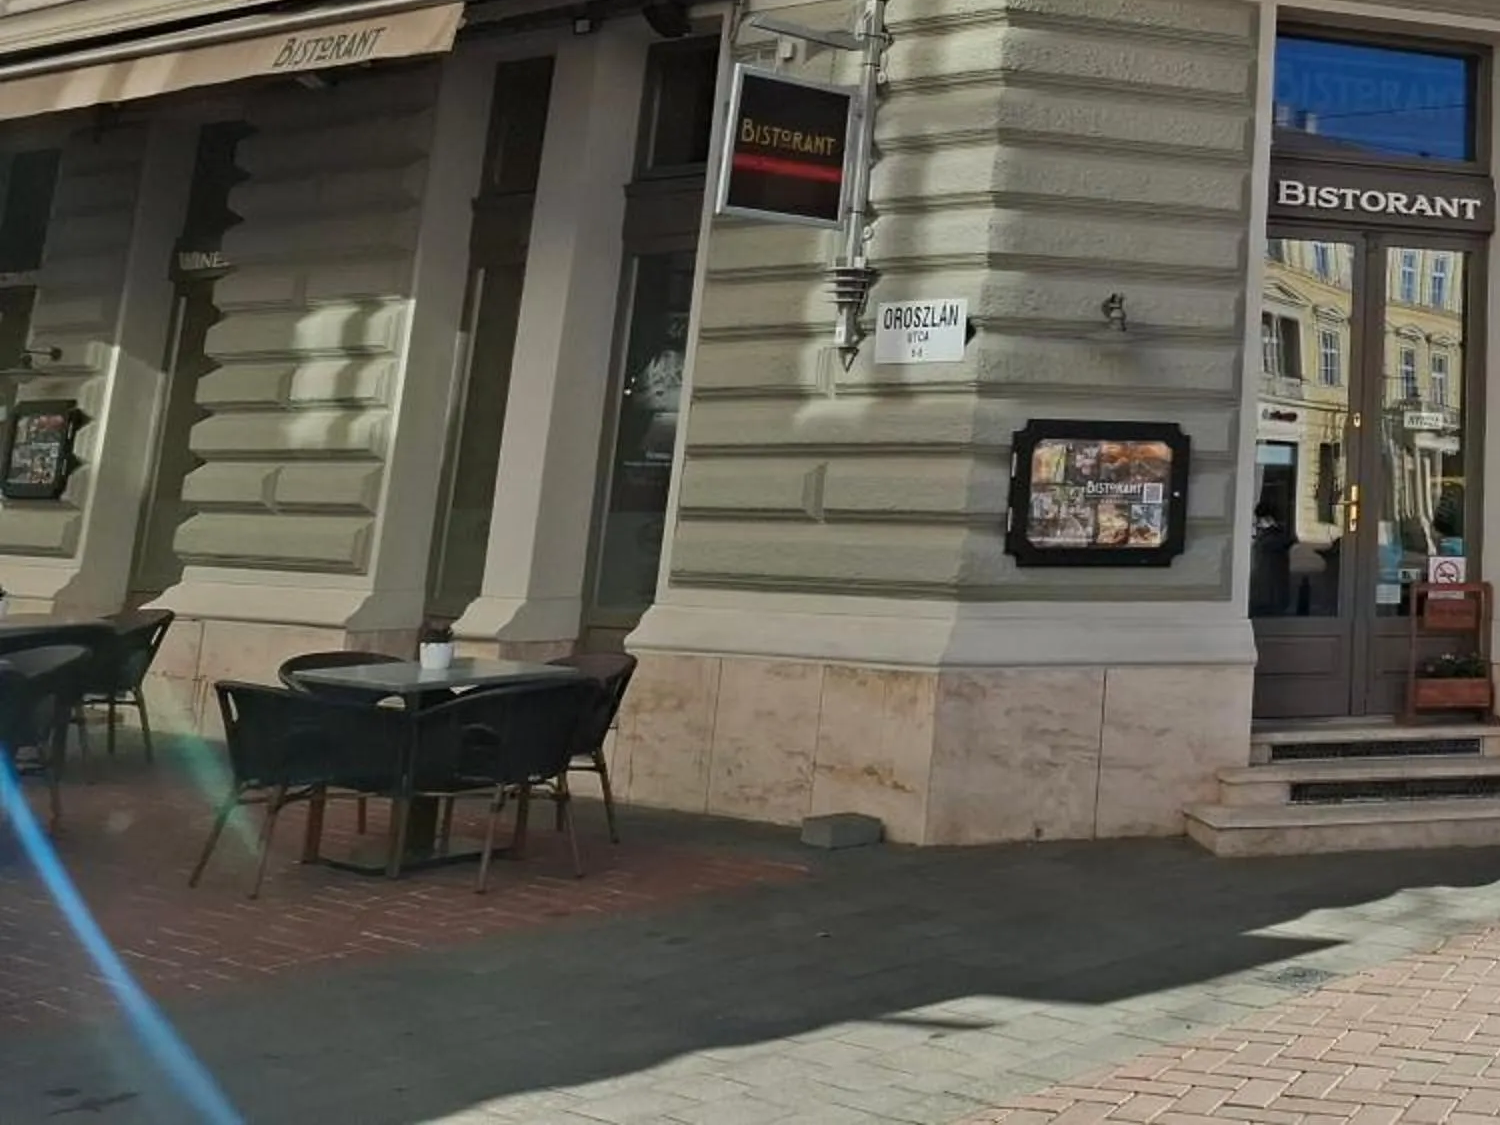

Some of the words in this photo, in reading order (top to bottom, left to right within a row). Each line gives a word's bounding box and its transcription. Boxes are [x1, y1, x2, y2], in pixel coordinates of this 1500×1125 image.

[271, 27, 387, 68] BISTORANT
[741, 118, 837, 155] BISTORANT
[1277, 179, 1481, 220] BISTORANT
